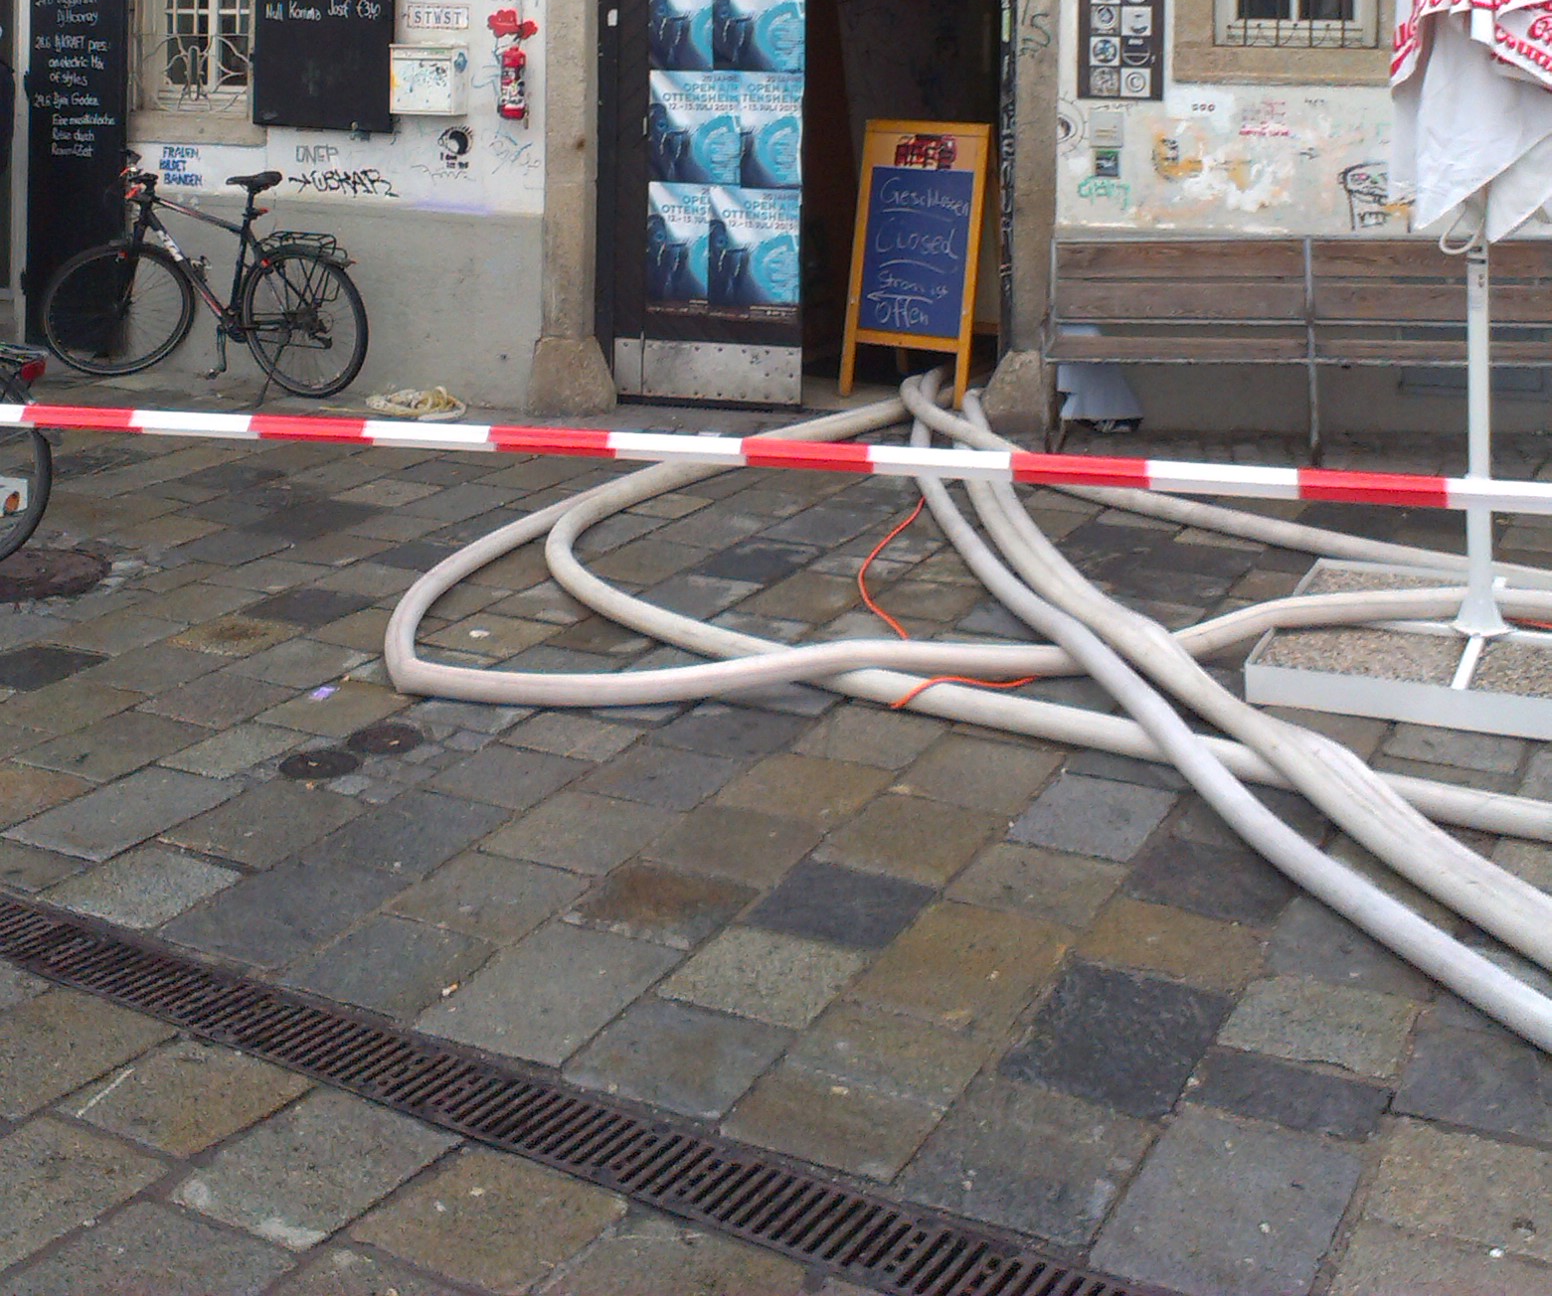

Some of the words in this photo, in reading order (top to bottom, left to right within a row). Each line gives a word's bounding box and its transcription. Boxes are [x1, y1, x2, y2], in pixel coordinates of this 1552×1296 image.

[288, 0, 321, 21] Komma
[414, 10, 463, 24] STWST
[684, 83, 716, 92] OPEN
[747, 83, 780, 93] OPEN
[662, 92, 739, 103] OTTENSHEIM
[744, 201, 777, 210] OPEN
[722, 209, 799, 221] OTTENSHEIM
[876, 218, 959, 260] Closed
